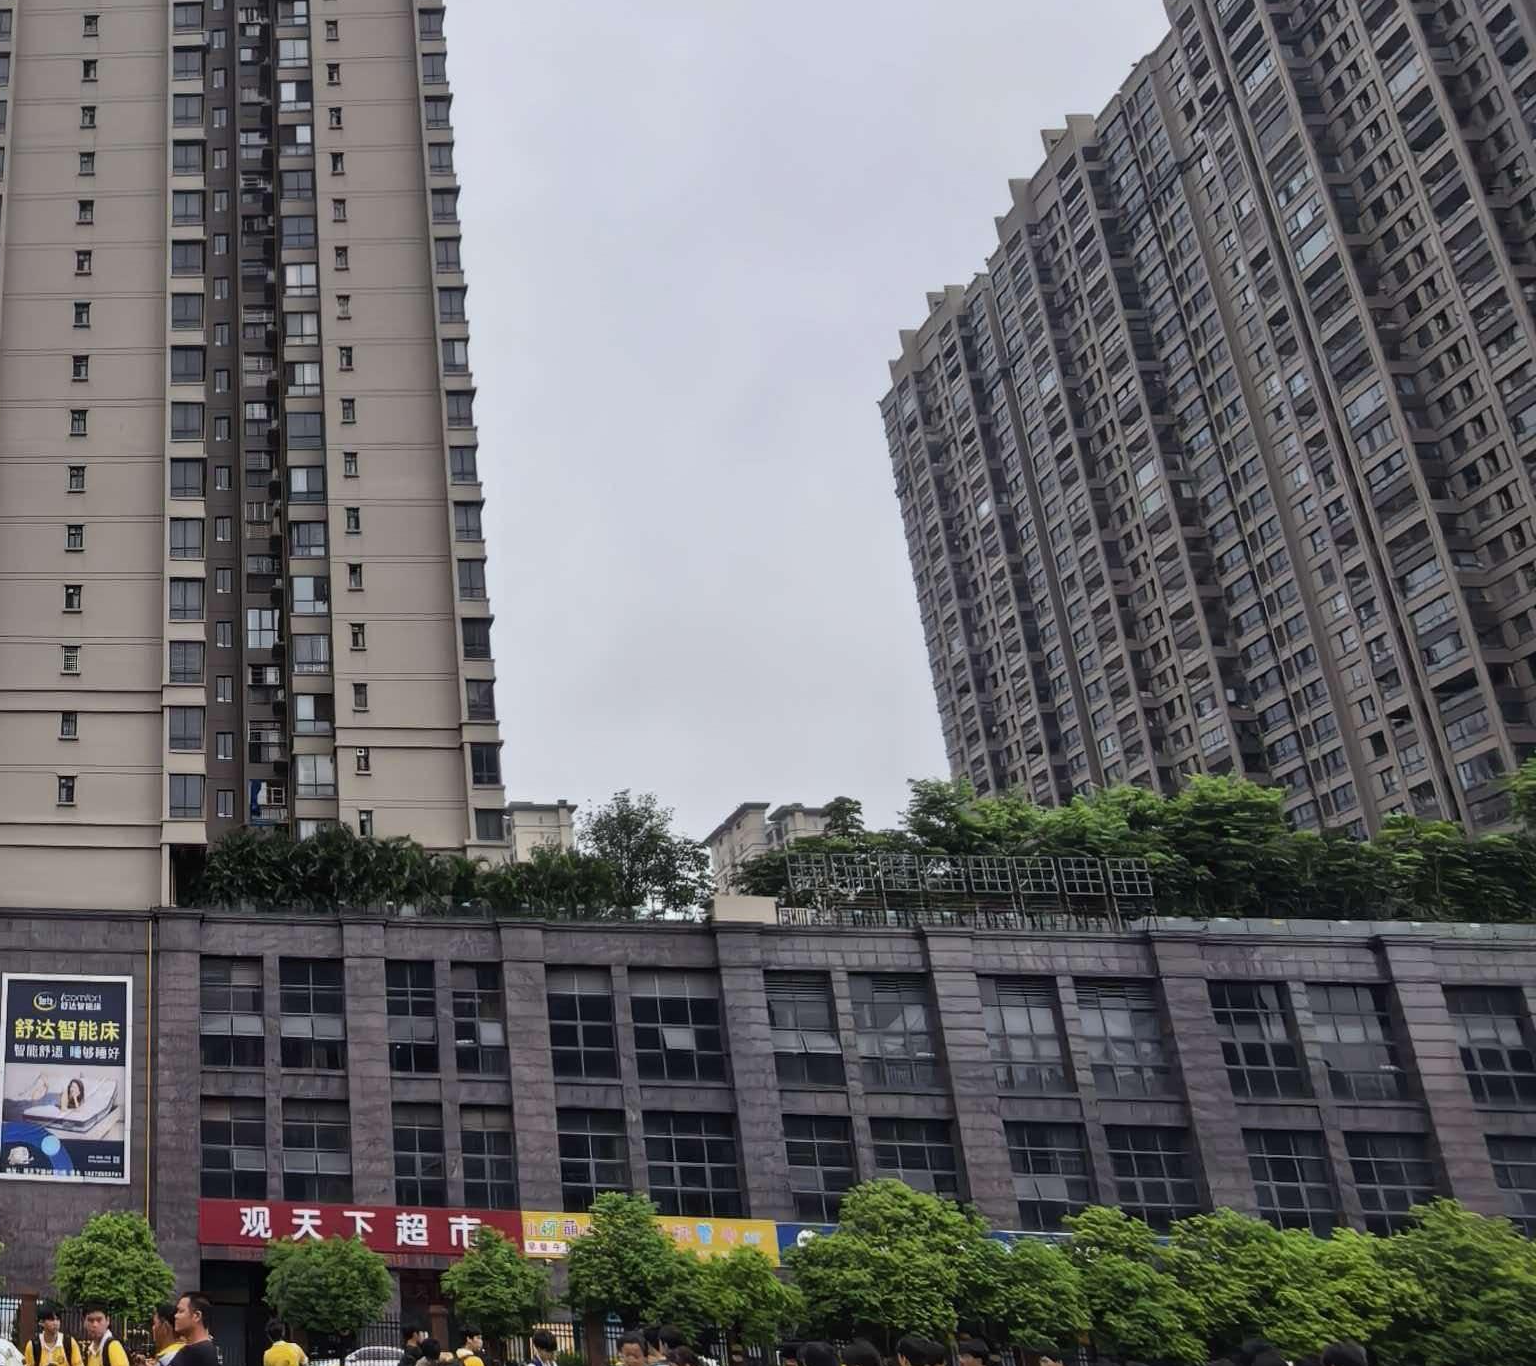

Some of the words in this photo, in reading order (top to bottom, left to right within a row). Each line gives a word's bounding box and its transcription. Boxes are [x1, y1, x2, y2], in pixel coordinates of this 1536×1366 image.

[15, 1017, 120, 1042] 舒达智能床
[238, 1206, 482, 1249] 观天下超市
